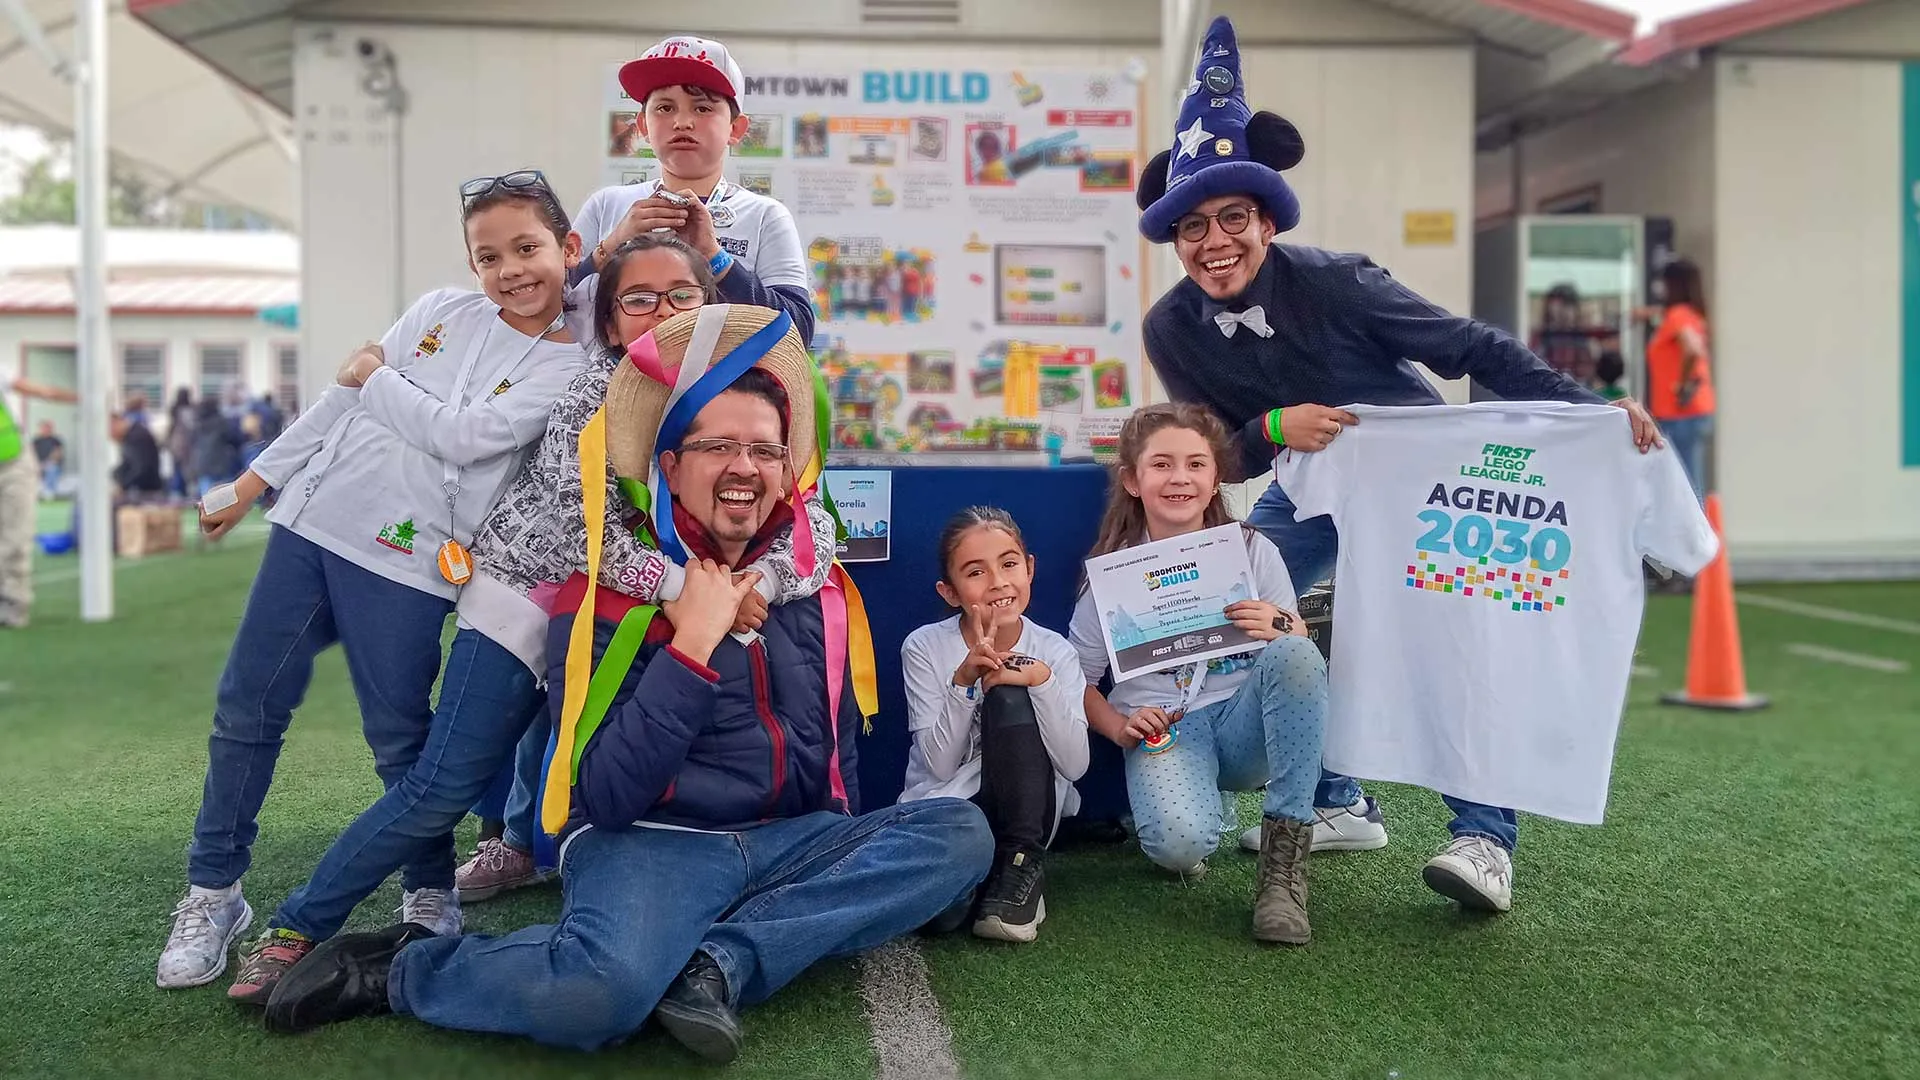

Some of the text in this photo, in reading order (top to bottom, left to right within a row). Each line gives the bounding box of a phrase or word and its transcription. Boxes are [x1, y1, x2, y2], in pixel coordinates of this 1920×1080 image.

[744, 71, 990, 103] MTOWN BUILD
[1482, 443, 1536, 460] FIRST
[1484, 456, 1526, 471] LEGO
[1460, 465, 1546, 487] LEAGUE JR.
[1426, 483, 1568, 526] AGENDA
[1415, 509, 1571, 572] 2030
[620, 566, 639, 586] SO
[1149, 561, 1197, 578] BOOMTOWN
[1160, 570, 1199, 587] BUILD
[1152, 646, 1172, 657] FIRST
